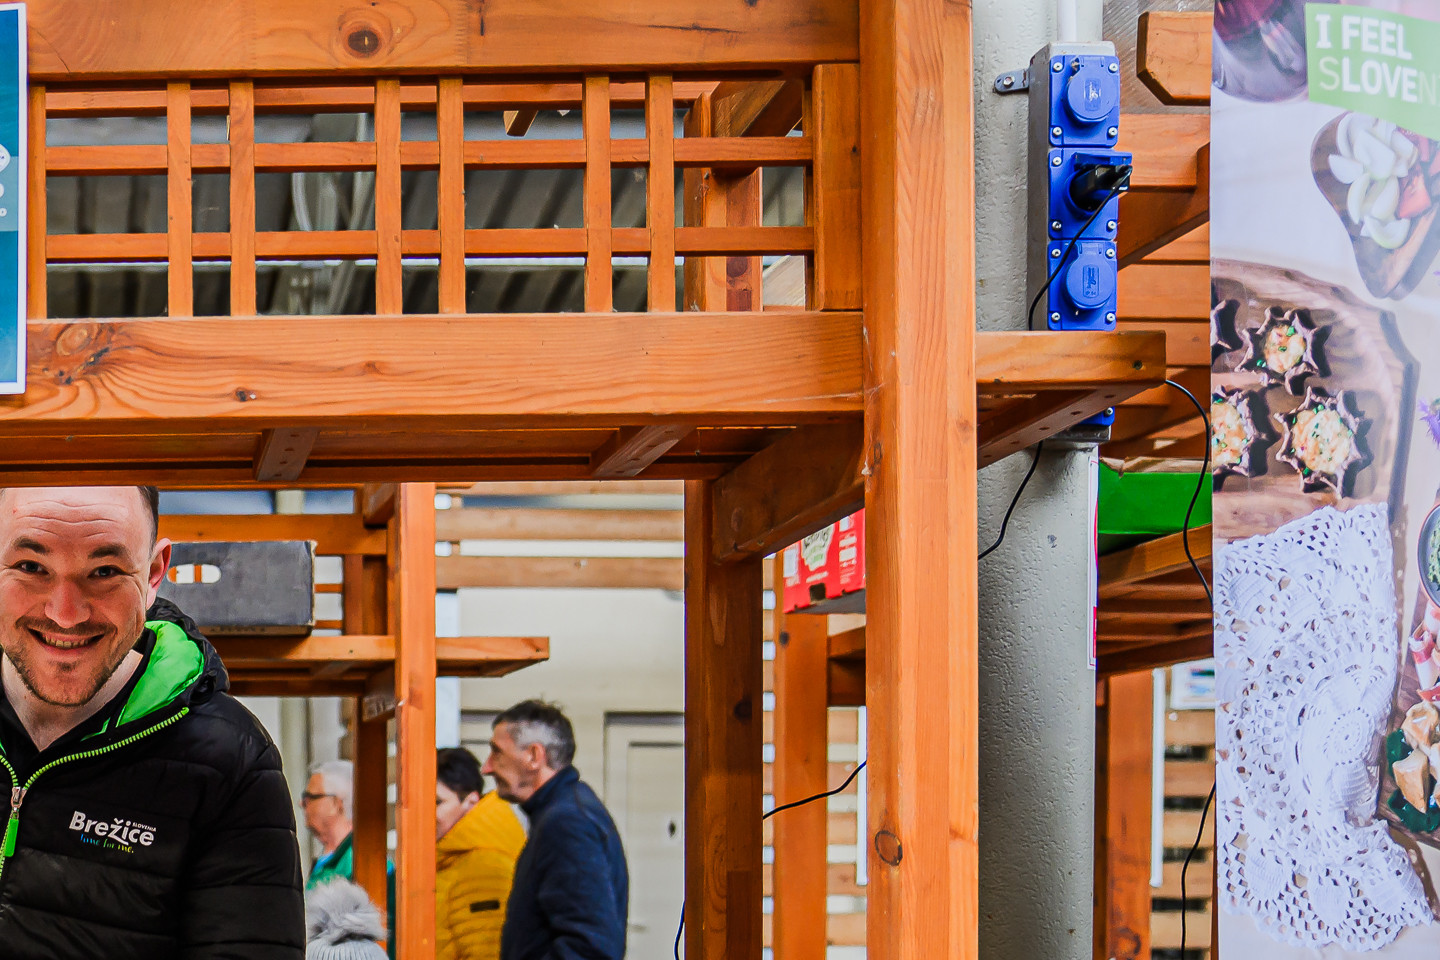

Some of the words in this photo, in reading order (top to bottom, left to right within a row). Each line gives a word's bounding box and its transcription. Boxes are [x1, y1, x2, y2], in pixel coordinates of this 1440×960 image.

[1315, 13, 1332, 49] I
[1342, 14, 1412, 60] FEEL
[1319, 56, 1440, 105] SLOVEN
[69, 811, 155, 846] Brežice
